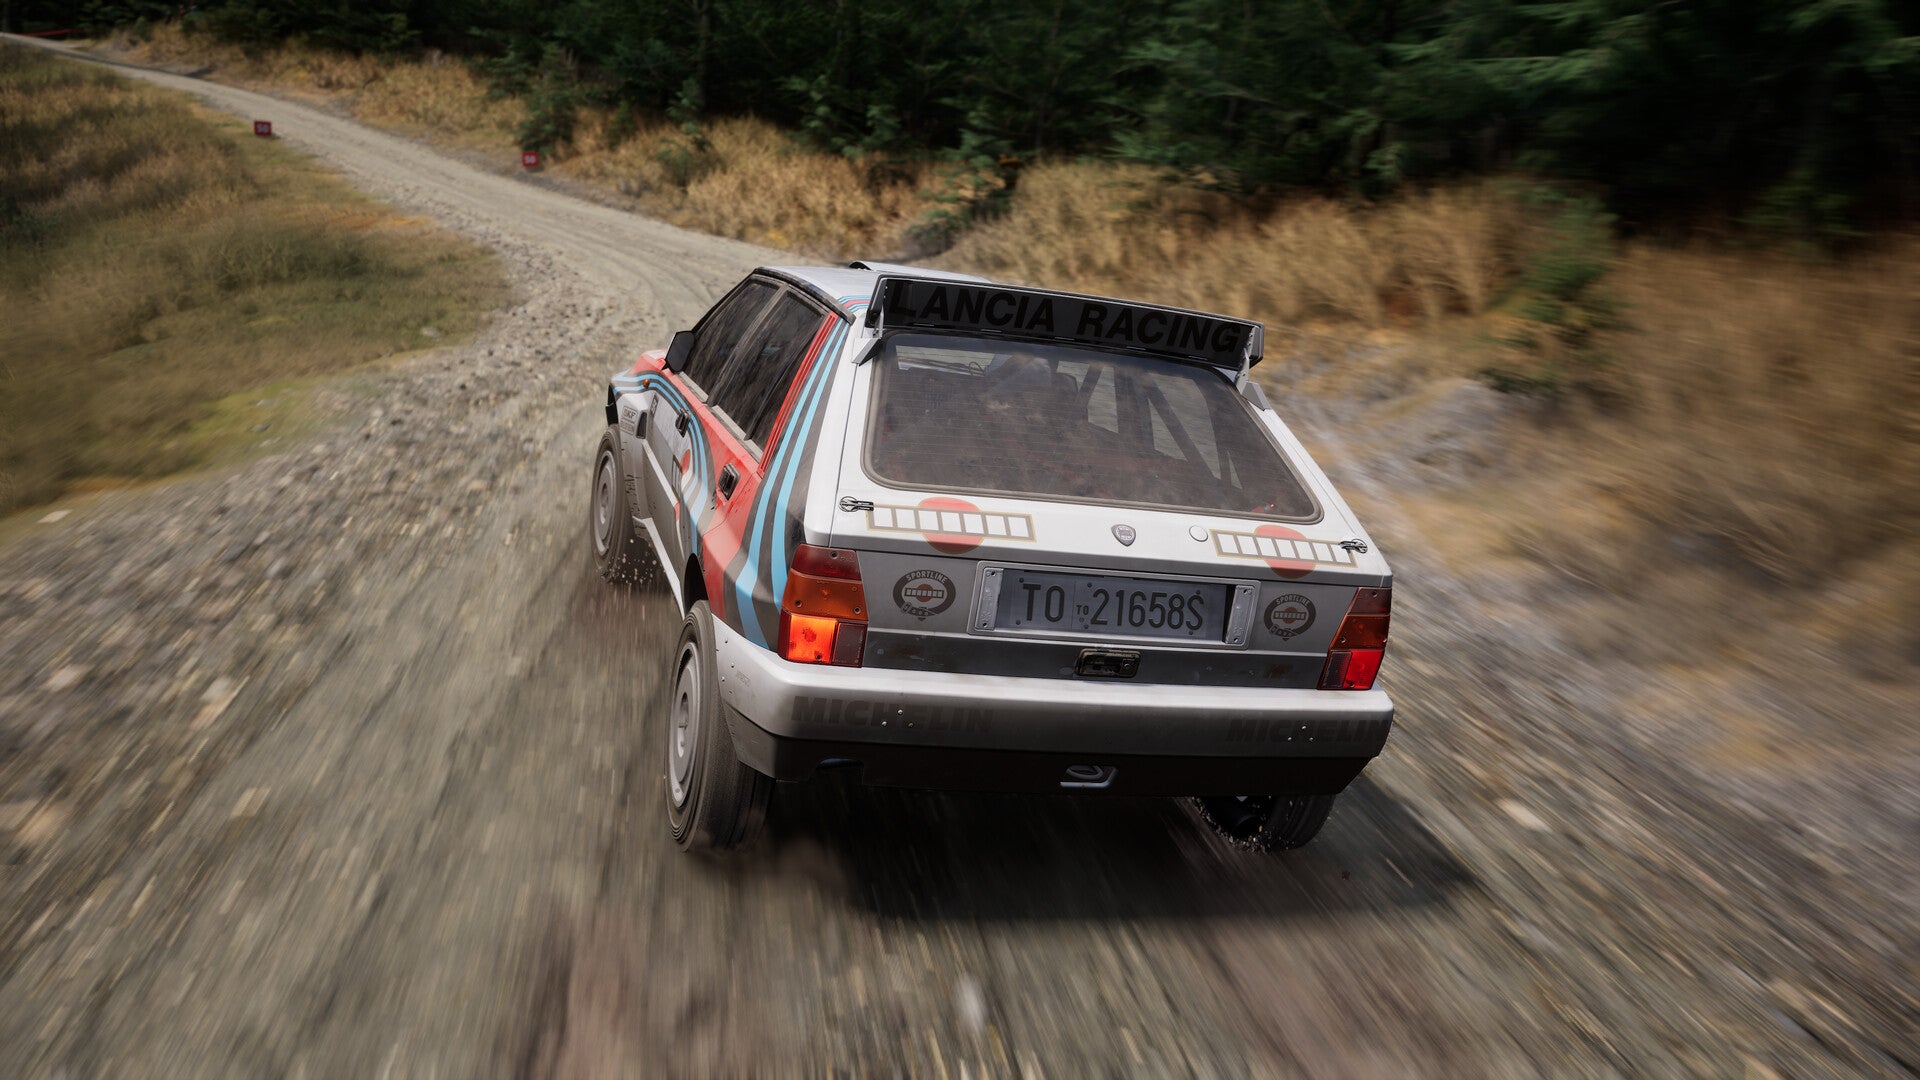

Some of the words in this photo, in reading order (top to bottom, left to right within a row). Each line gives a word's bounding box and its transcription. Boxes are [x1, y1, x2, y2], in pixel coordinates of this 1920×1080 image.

[887, 279, 1056, 333] LANCIA
[1075, 301, 1243, 354] RACING
[905, 570, 948, 584] SPORTLINE
[1022, 583, 1066, 622] TO
[1076, 604, 1089, 616] TO
[1090, 588, 1205, 631] 21658S
[792, 695, 994, 733] MICHELIN
